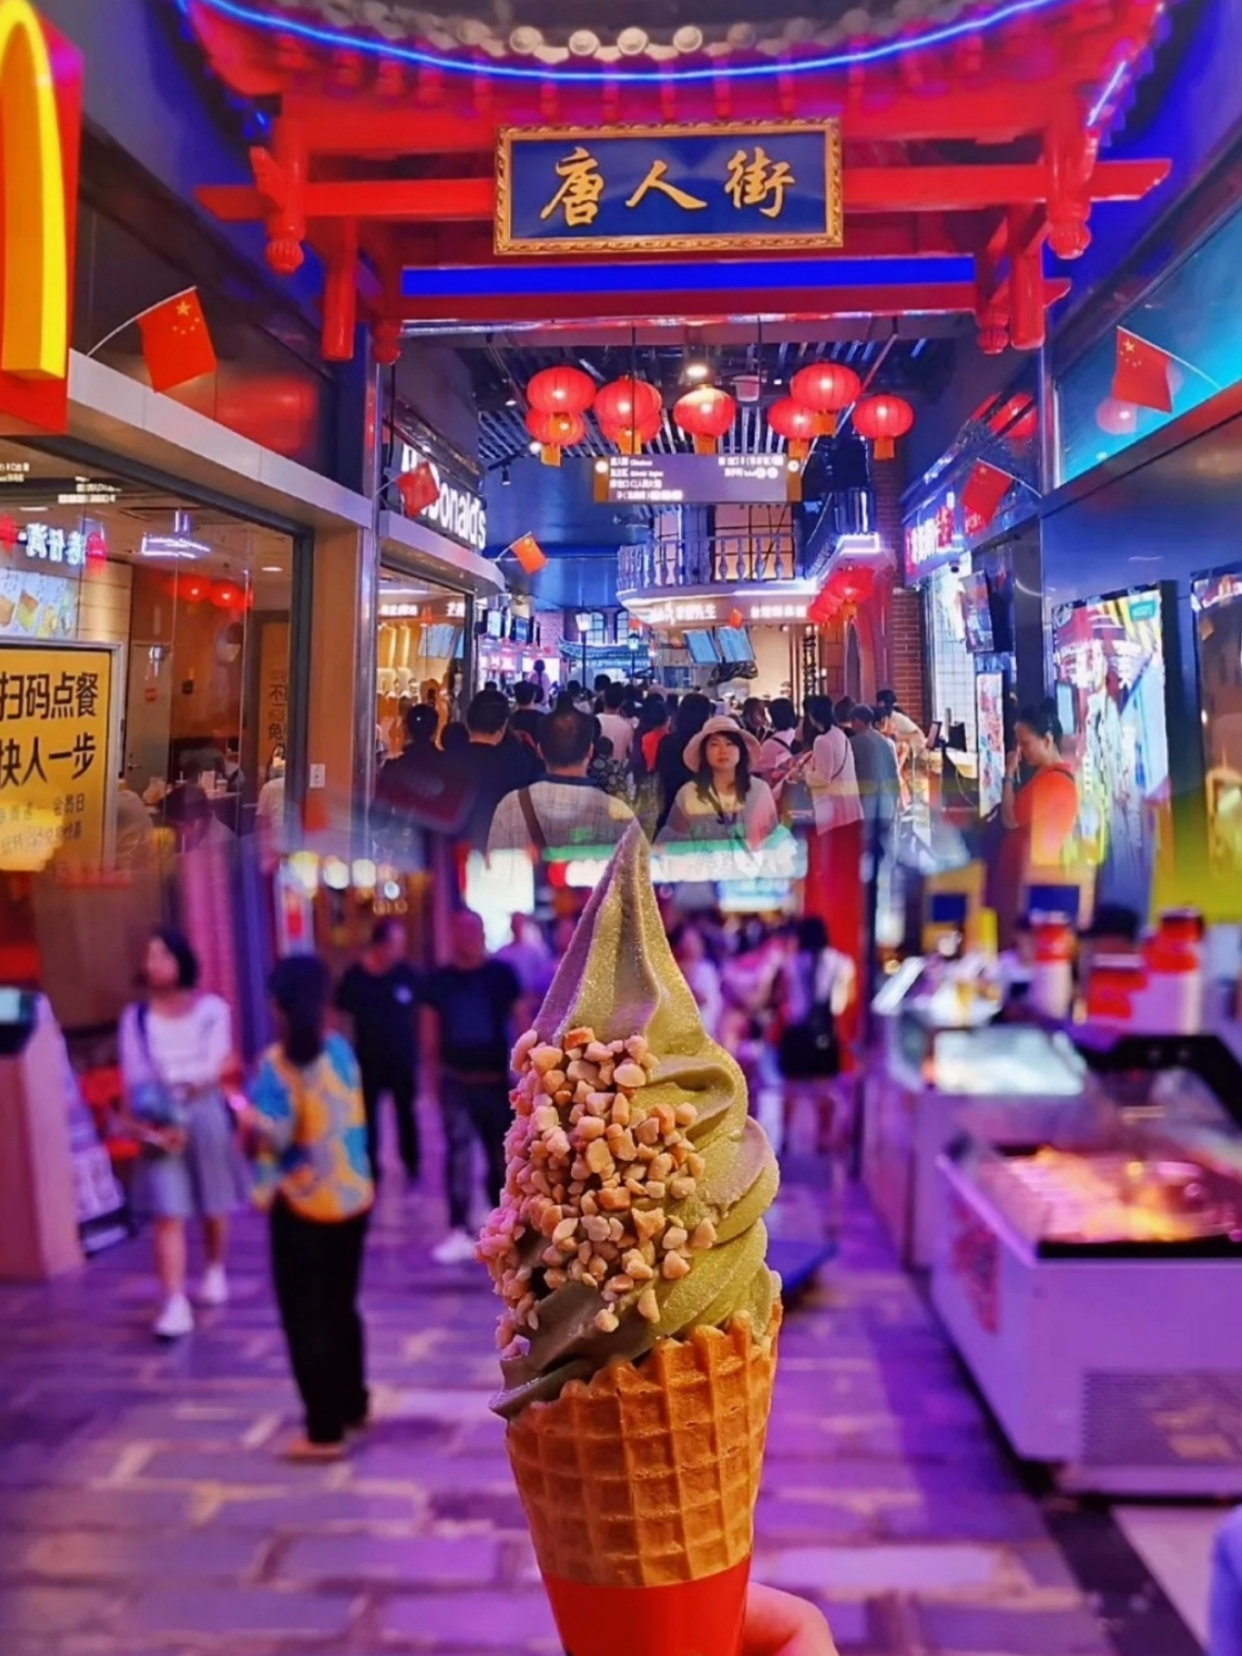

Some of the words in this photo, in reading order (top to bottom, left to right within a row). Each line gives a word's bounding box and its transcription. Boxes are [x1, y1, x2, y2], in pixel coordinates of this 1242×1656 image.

[540, 146, 795, 227] 唐人街
[0, 672, 98, 721] 扫码点餐
